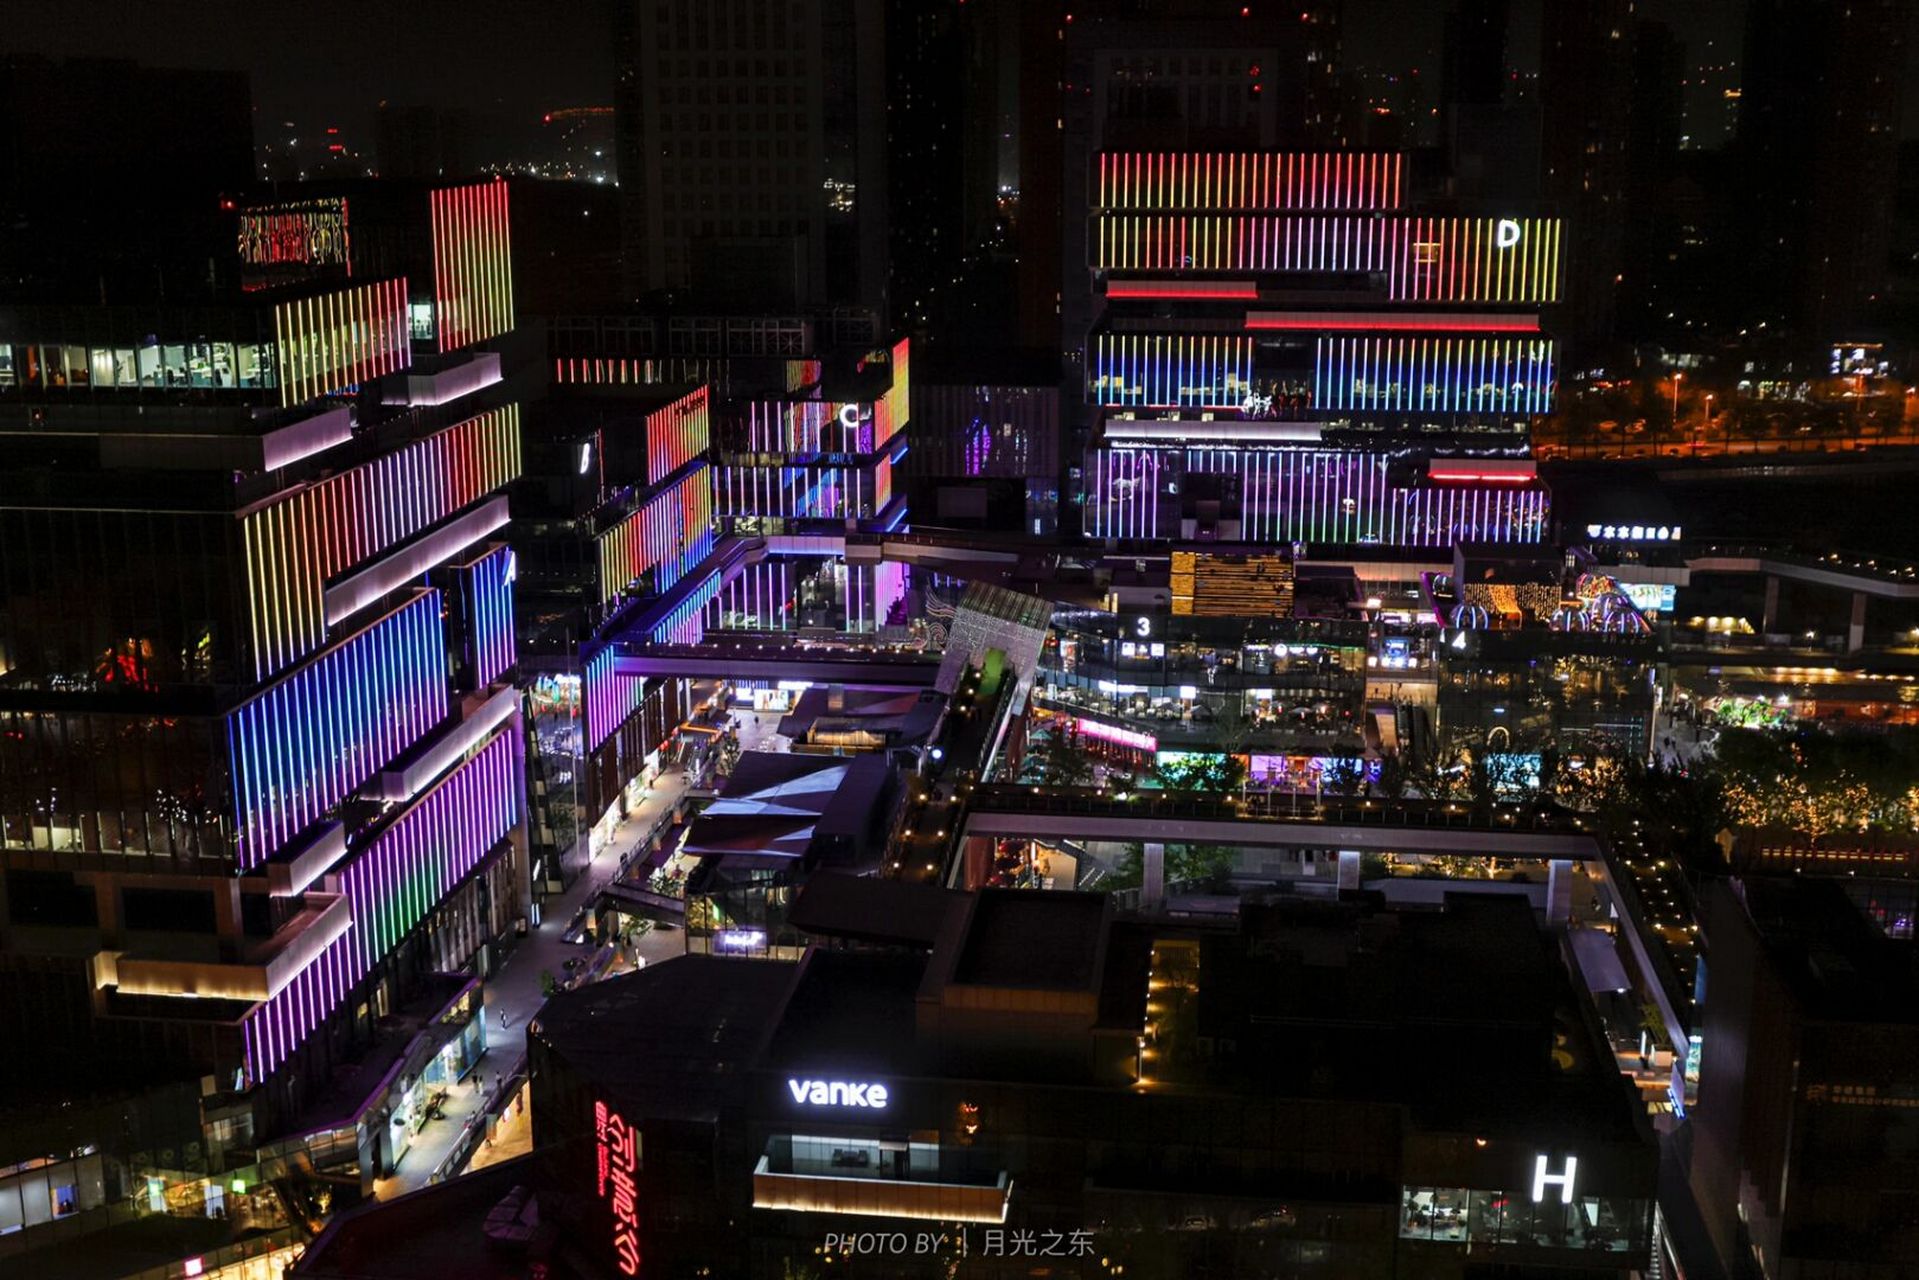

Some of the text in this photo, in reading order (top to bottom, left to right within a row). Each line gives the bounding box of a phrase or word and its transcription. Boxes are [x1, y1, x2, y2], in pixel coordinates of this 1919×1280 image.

[1497, 219, 1521, 247] D
[838, 403, 859, 428] C
[503, 550, 517, 586] A
[1137, 616, 1151, 637] 3
[1452, 631, 1467, 650] 4
[789, 1079, 889, 1109] vanke
[1532, 1155, 1577, 1204] H
